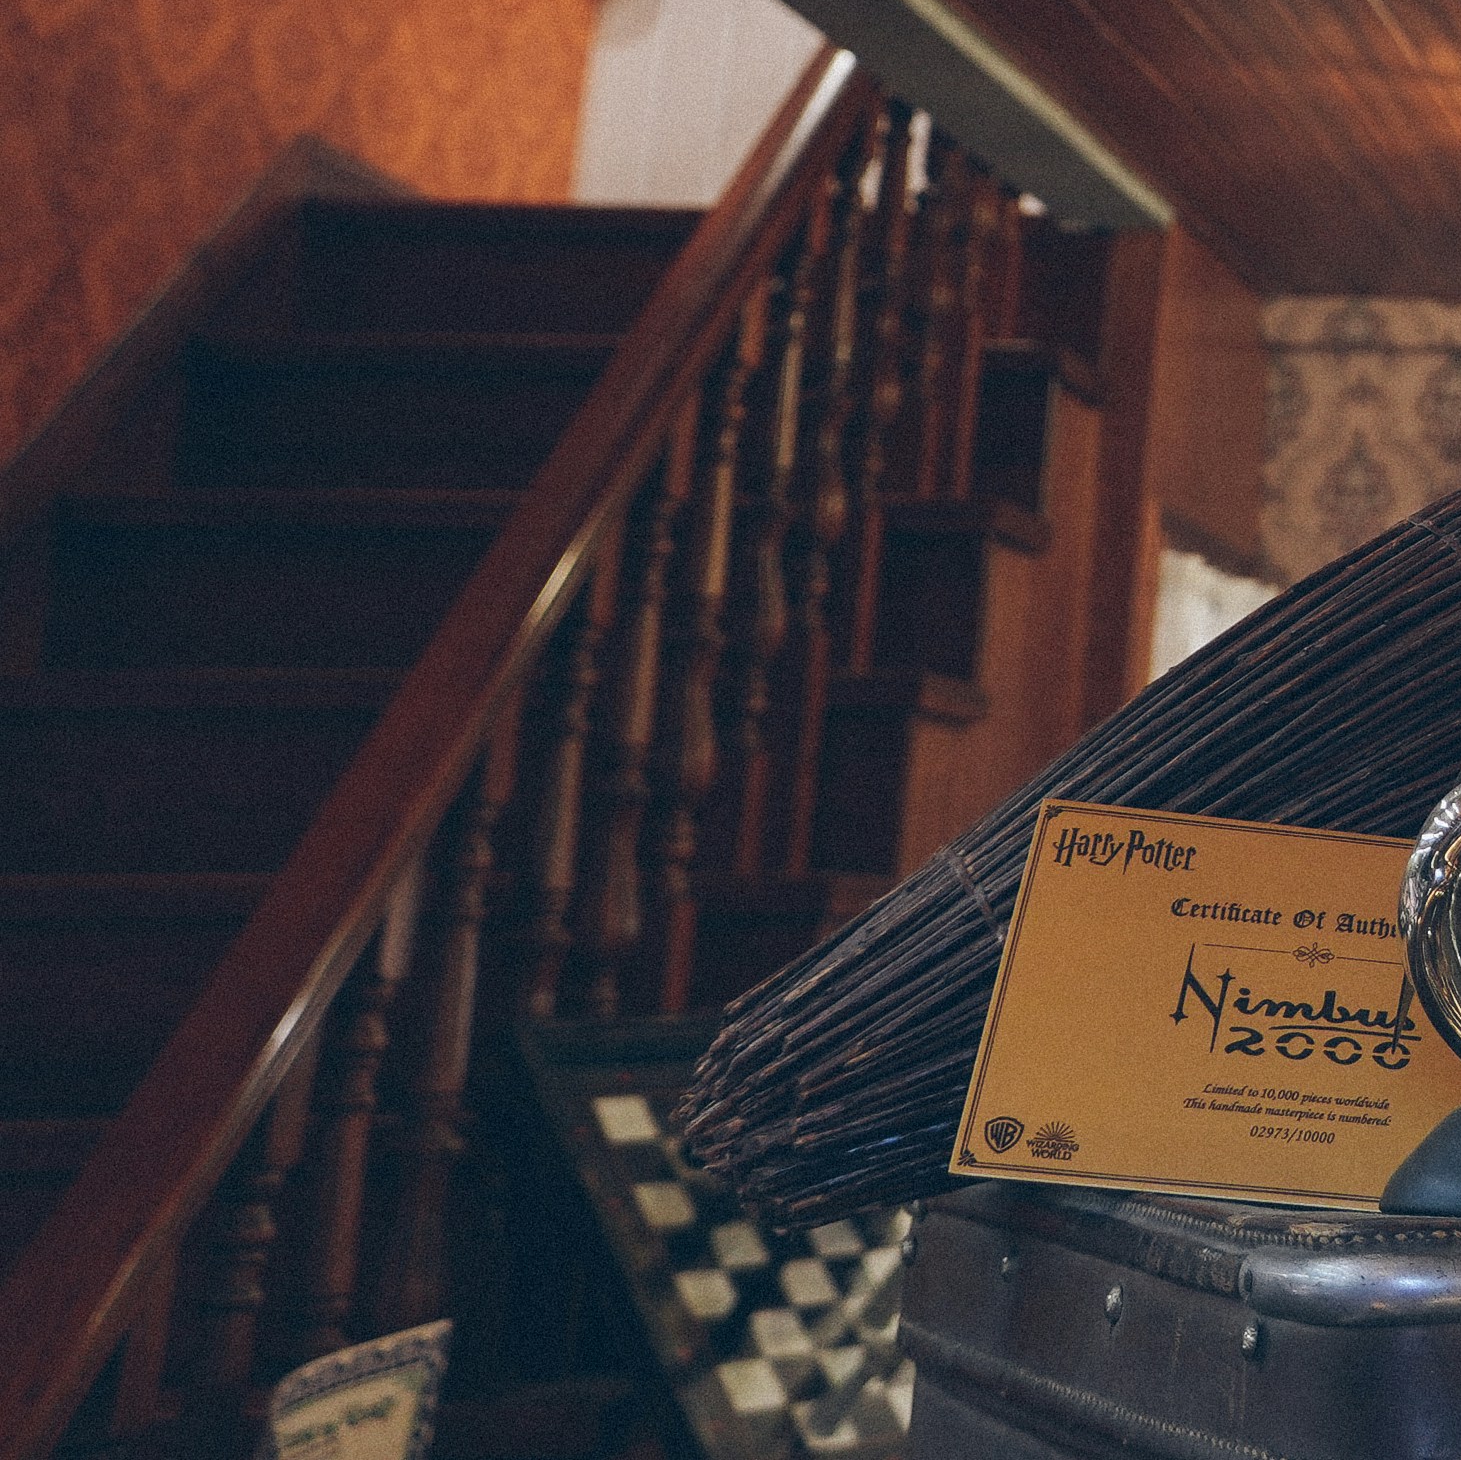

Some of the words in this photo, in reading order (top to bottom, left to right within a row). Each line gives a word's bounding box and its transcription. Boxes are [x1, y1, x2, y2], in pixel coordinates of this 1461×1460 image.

[1053, 827, 1125, 868] Harry
[1122, 829, 1197, 875] Potter
[1170, 897, 1283, 926] Certificate
[1292, 909, 1327, 930] Of
[1224, 1026, 1412, 1070] 2000
[1183, 1097, 1206, 1110] This
[1208, 1099, 1262, 1115] handmade
[1264, 1105, 1325, 1122] masterpiece
[1327, 1110, 1336, 1122] is
[1338, 1114, 1392, 1127] numbered:
[1202, 1083, 1248, 1097] Limited
[1248, 1086, 1259, 1098] to
[1260, 1087, 1300, 1101] 10,000
[1300, 1091, 1333, 1106] pieces
[1334, 1094, 1391, 1111] worldwide
[988, 1120, 1020, 1150] WB
[1025, 1139, 1080, 1153] WIZARDING
[1249, 1124, 1336, 1145] 02973/10000
[1030, 1148, 1073, 1161] WORLD
